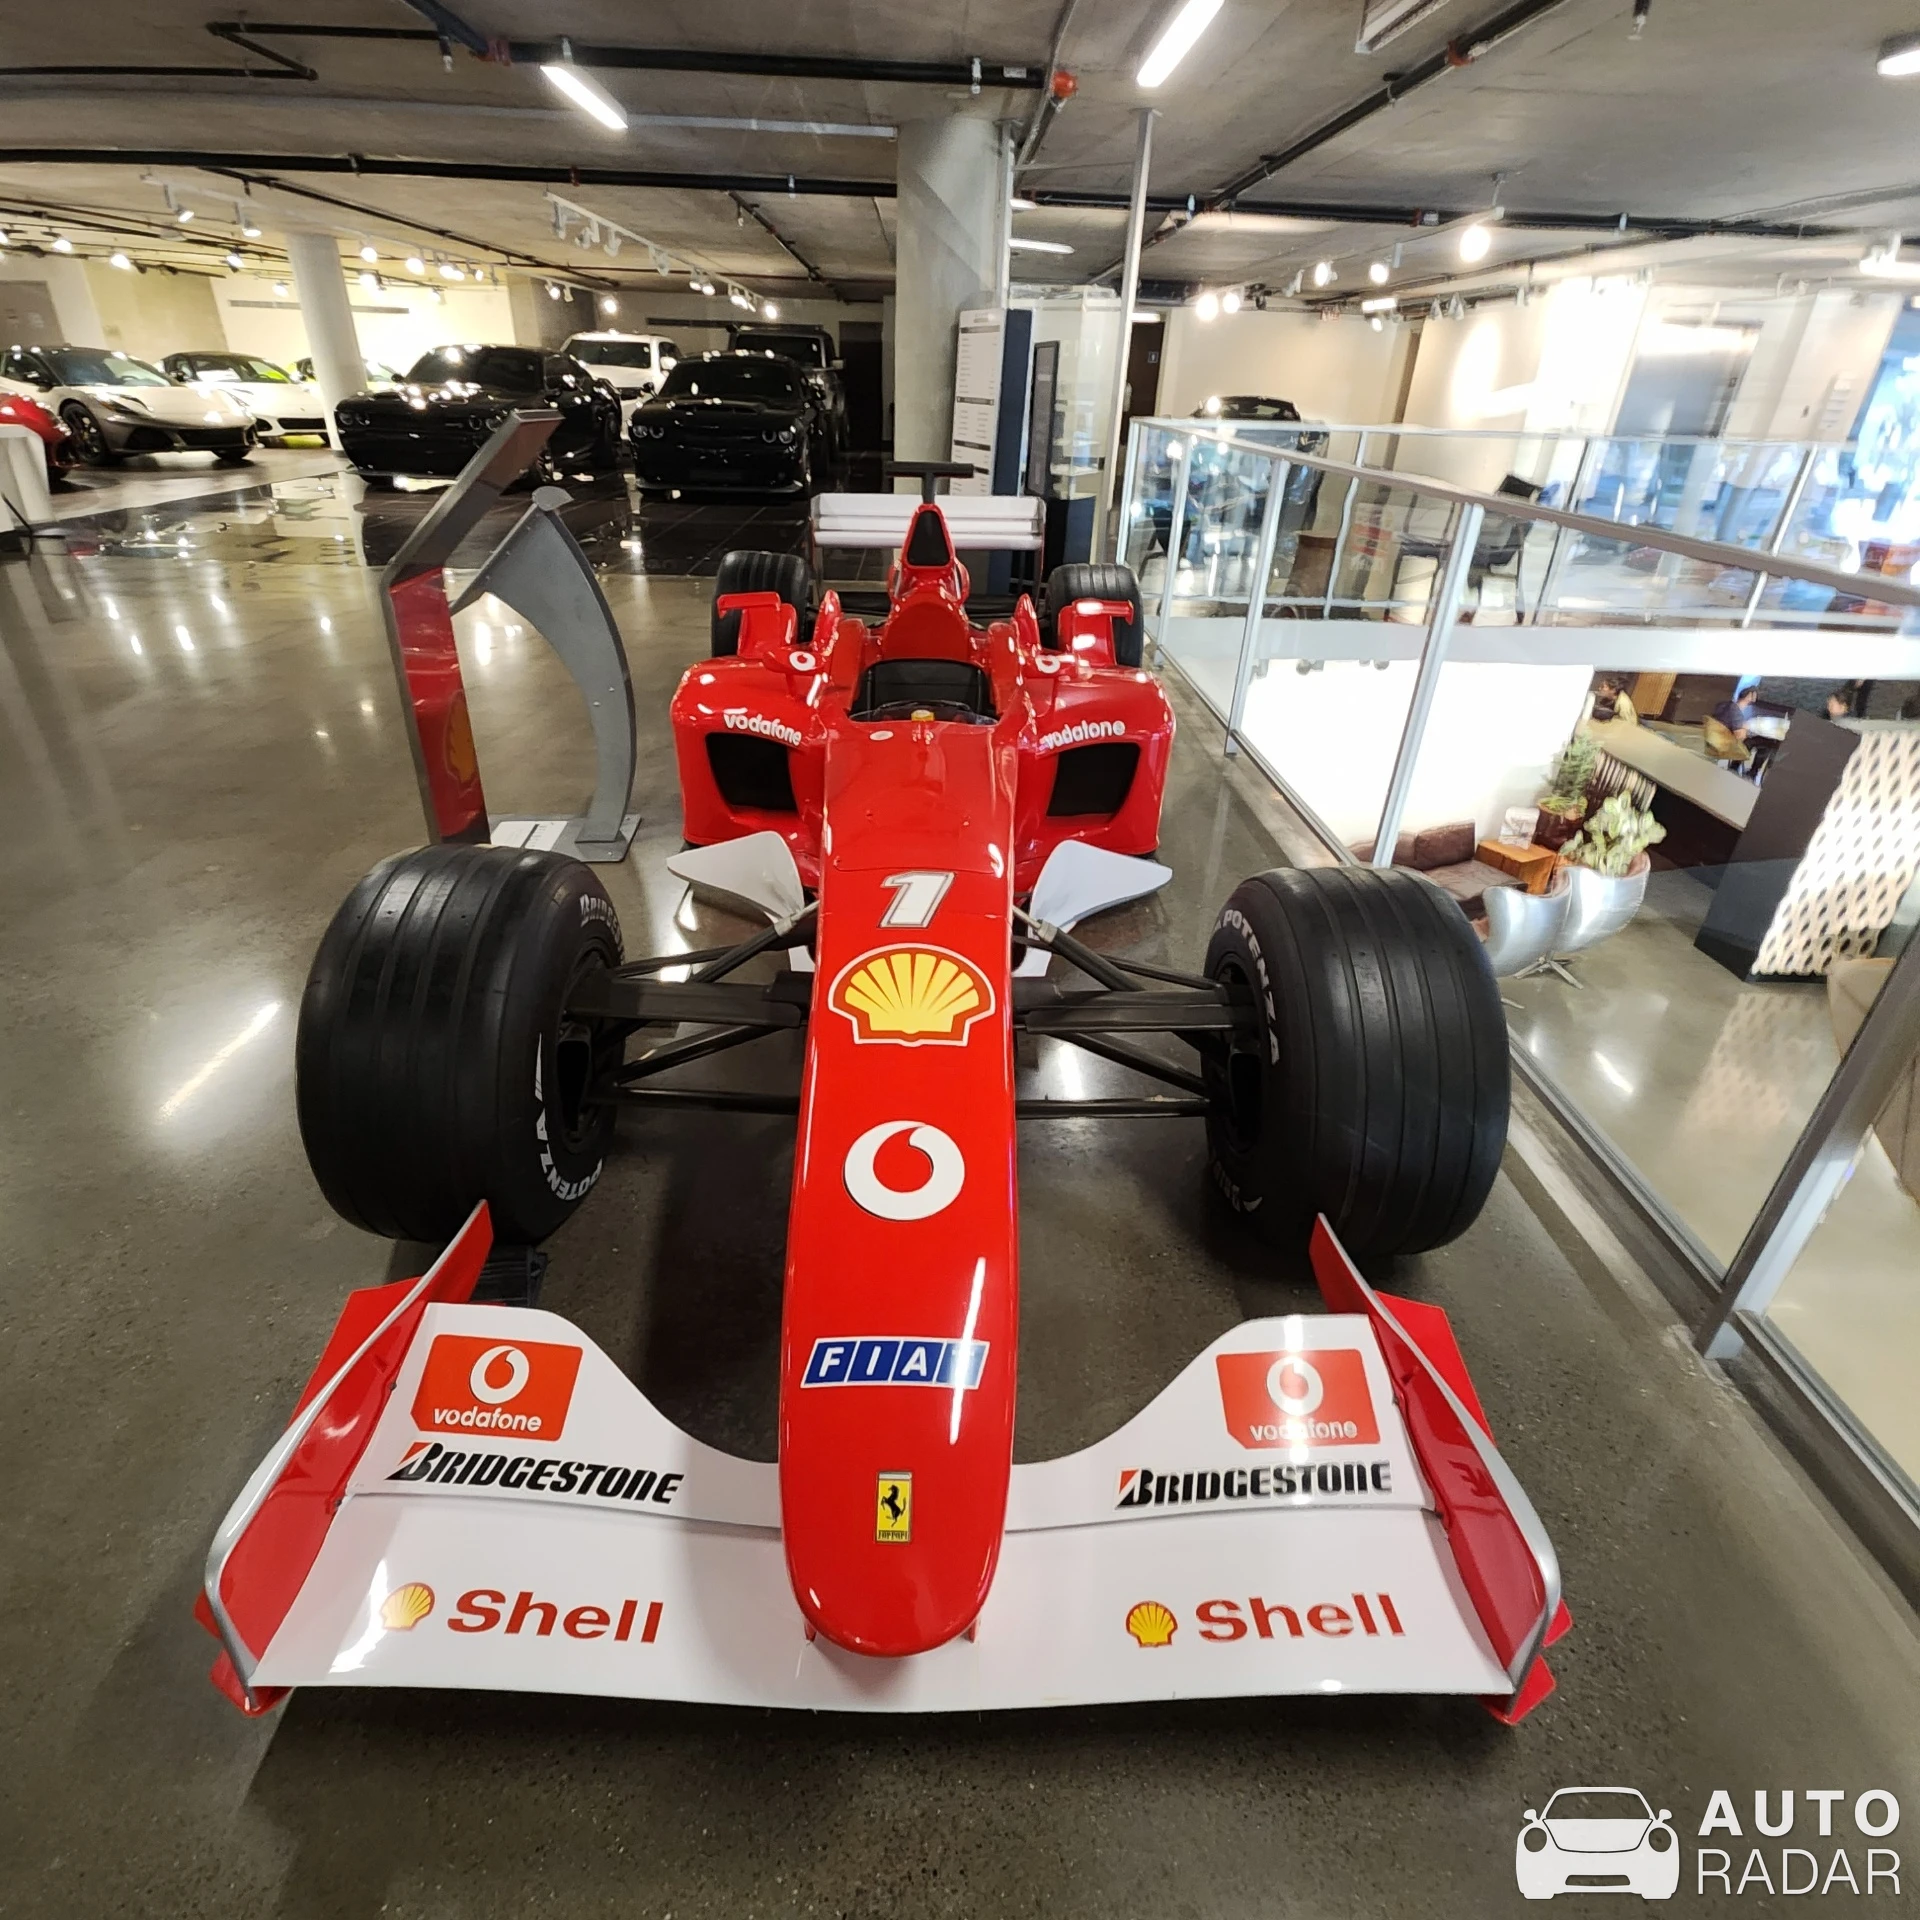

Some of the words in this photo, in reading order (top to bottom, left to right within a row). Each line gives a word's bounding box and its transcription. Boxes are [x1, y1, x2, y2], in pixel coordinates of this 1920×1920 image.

[724, 713, 802, 746] vodafone
[1040, 720, 1126, 750] vodafone
[877, 871, 956, 929] 1
[536, 1107, 603, 1200] POTENZA
[433, 1407, 542, 1433] vodafone
[384, 1442, 685, 1504] BRIDGESTONE
[1115, 1460, 1392, 1510] BRIDGESTONE
[447, 1589, 664, 1644] Shell
[1195, 1592, 1406, 1642] Shell
